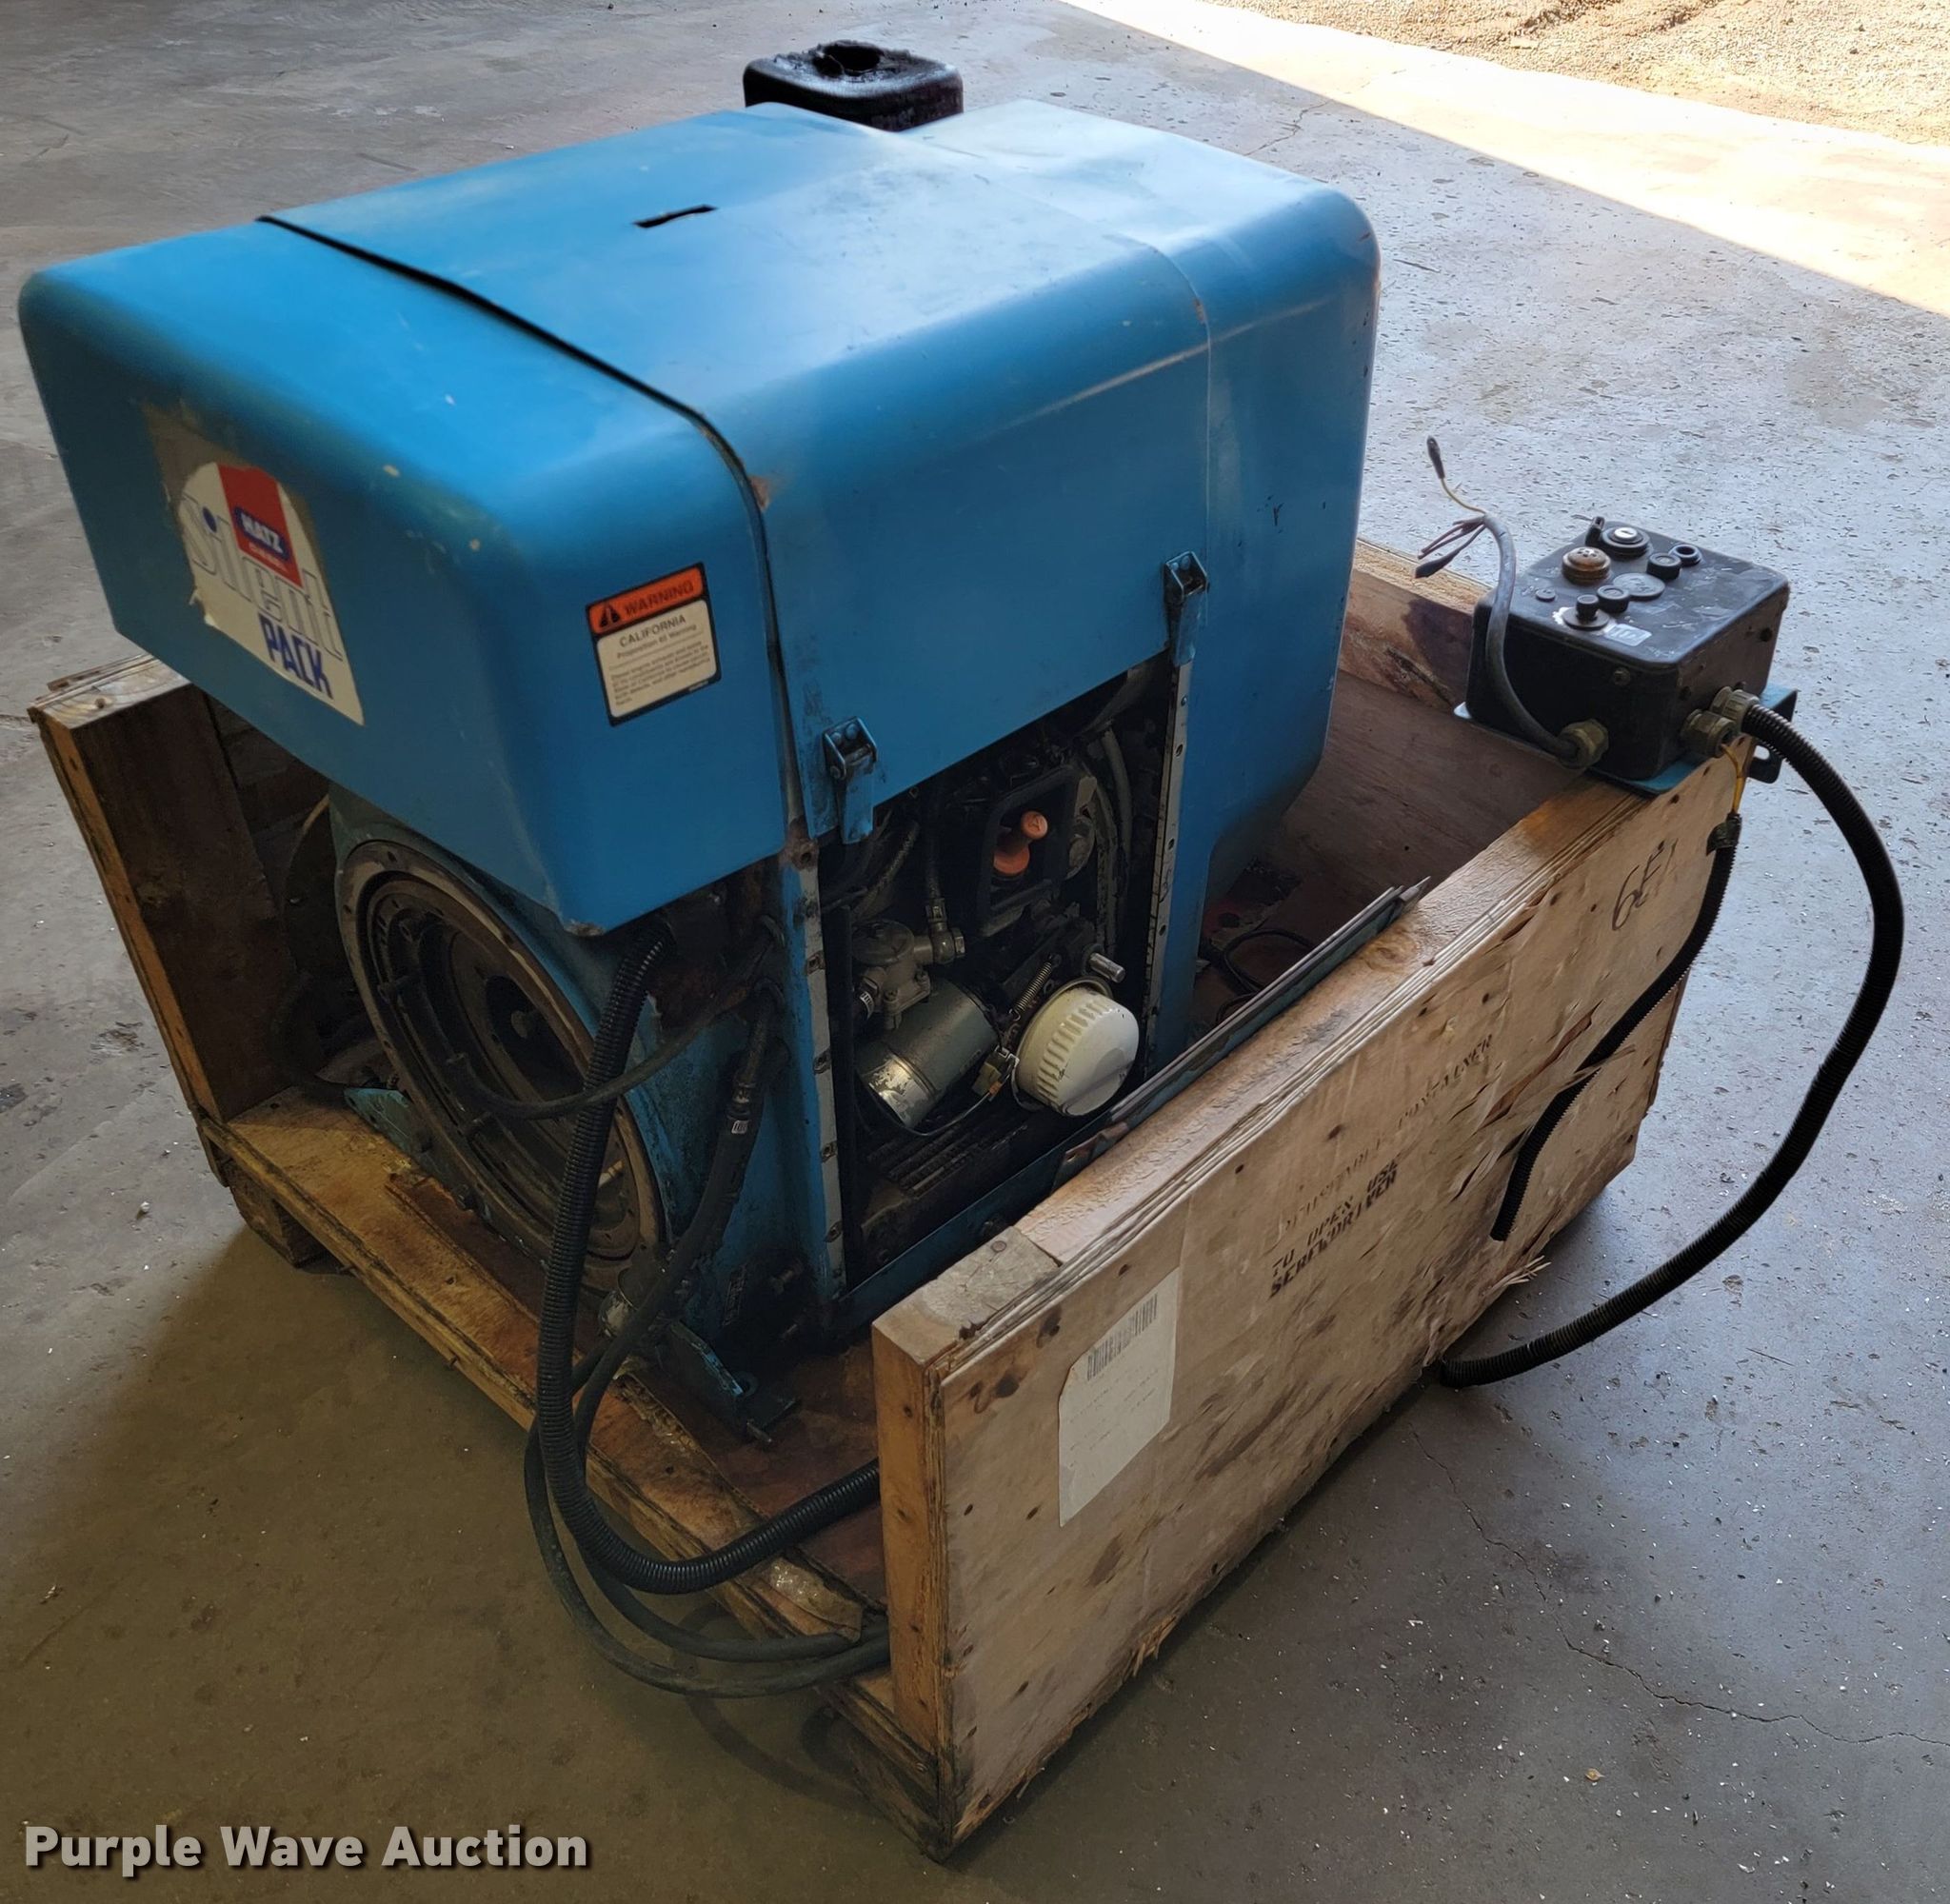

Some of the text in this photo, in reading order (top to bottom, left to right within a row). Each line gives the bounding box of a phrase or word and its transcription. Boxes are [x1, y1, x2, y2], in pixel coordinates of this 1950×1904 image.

[624, 580, 694, 616] WARNING
[619, 614, 686, 647] CALIFORNIA
[258, 612, 333, 700] PACK
[1366, 1159, 1399, 1193] USE
